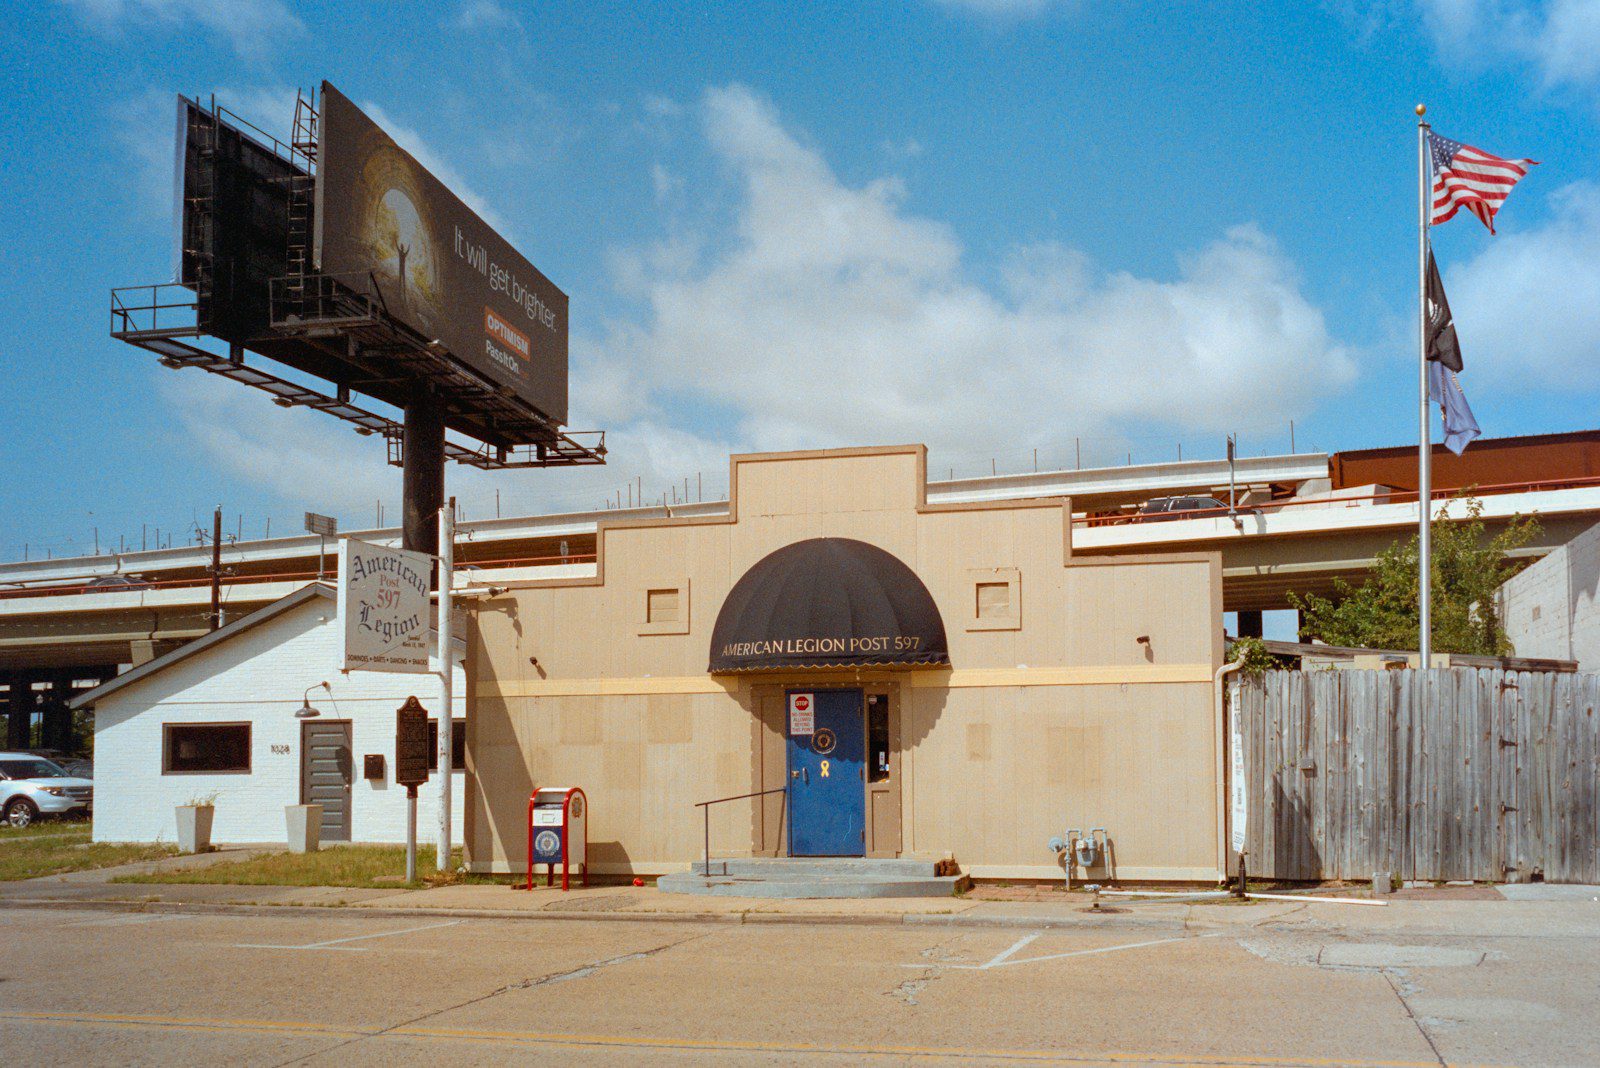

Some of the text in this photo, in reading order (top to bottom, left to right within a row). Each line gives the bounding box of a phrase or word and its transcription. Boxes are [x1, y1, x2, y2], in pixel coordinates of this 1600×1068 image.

[454, 225, 557, 332] It will get brighter.
[487, 314, 529, 355] OPTIMISM
[349, 554, 427, 597] American
[380, 574, 400, 587] Post
[377, 588, 400, 610] 597
[358, 600, 420, 644] Legion
[722, 636, 920, 656] AMERICAN LEGION POST 597
